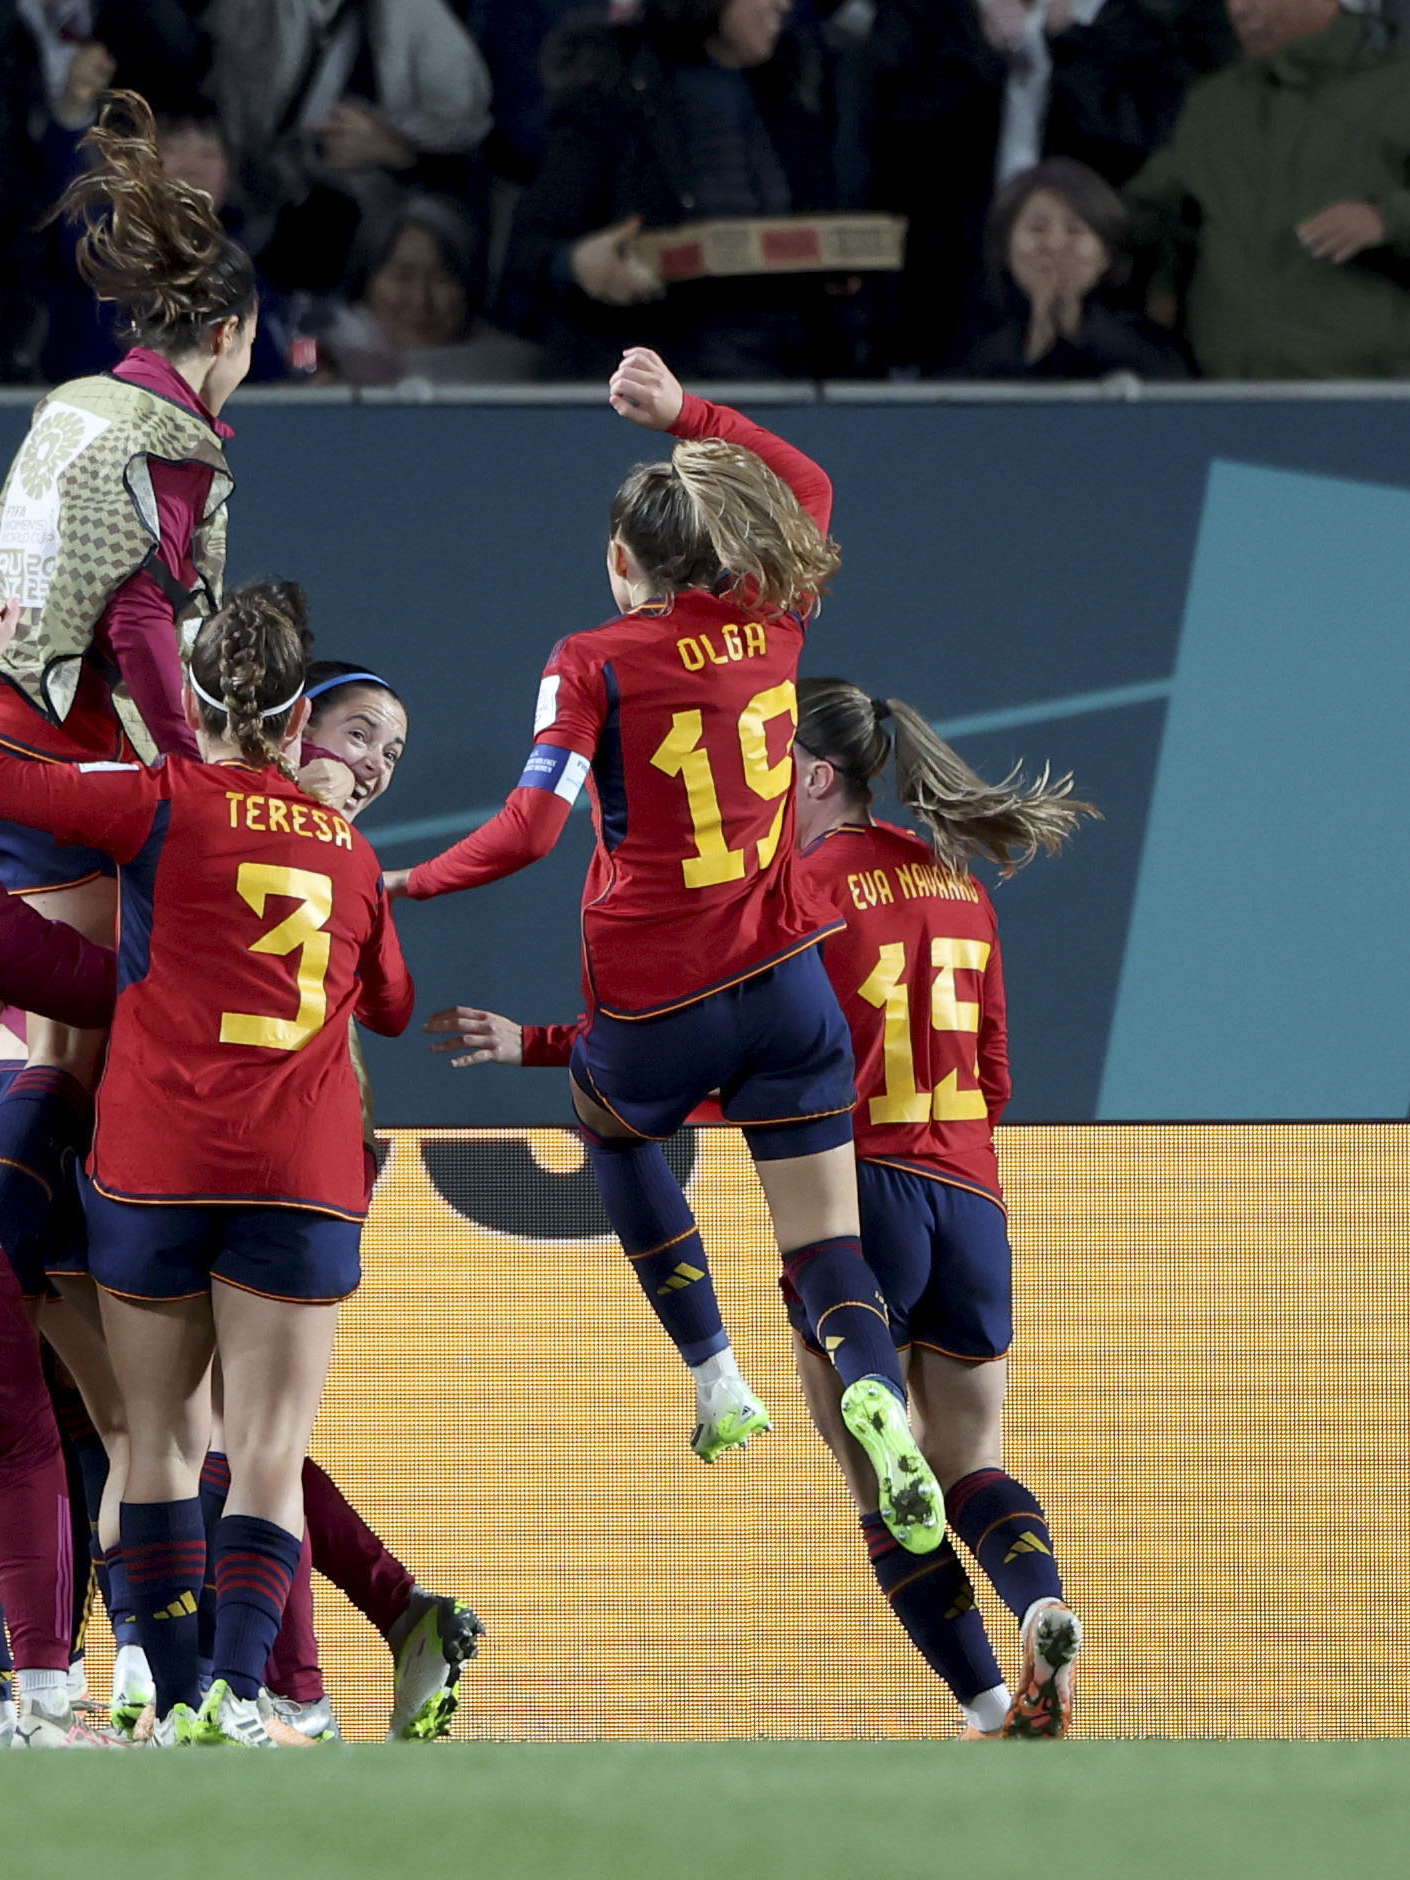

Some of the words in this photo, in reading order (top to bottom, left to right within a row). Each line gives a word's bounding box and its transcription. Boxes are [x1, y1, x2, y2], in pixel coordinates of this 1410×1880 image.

[676, 622, 767, 671] OLGA
[225, 791, 353, 851] TERESA
[650, 680, 797, 889] 19
[847, 868, 895, 910] EVA
[219, 862, 333, 1051] 3
[857, 937, 992, 1125] 15
